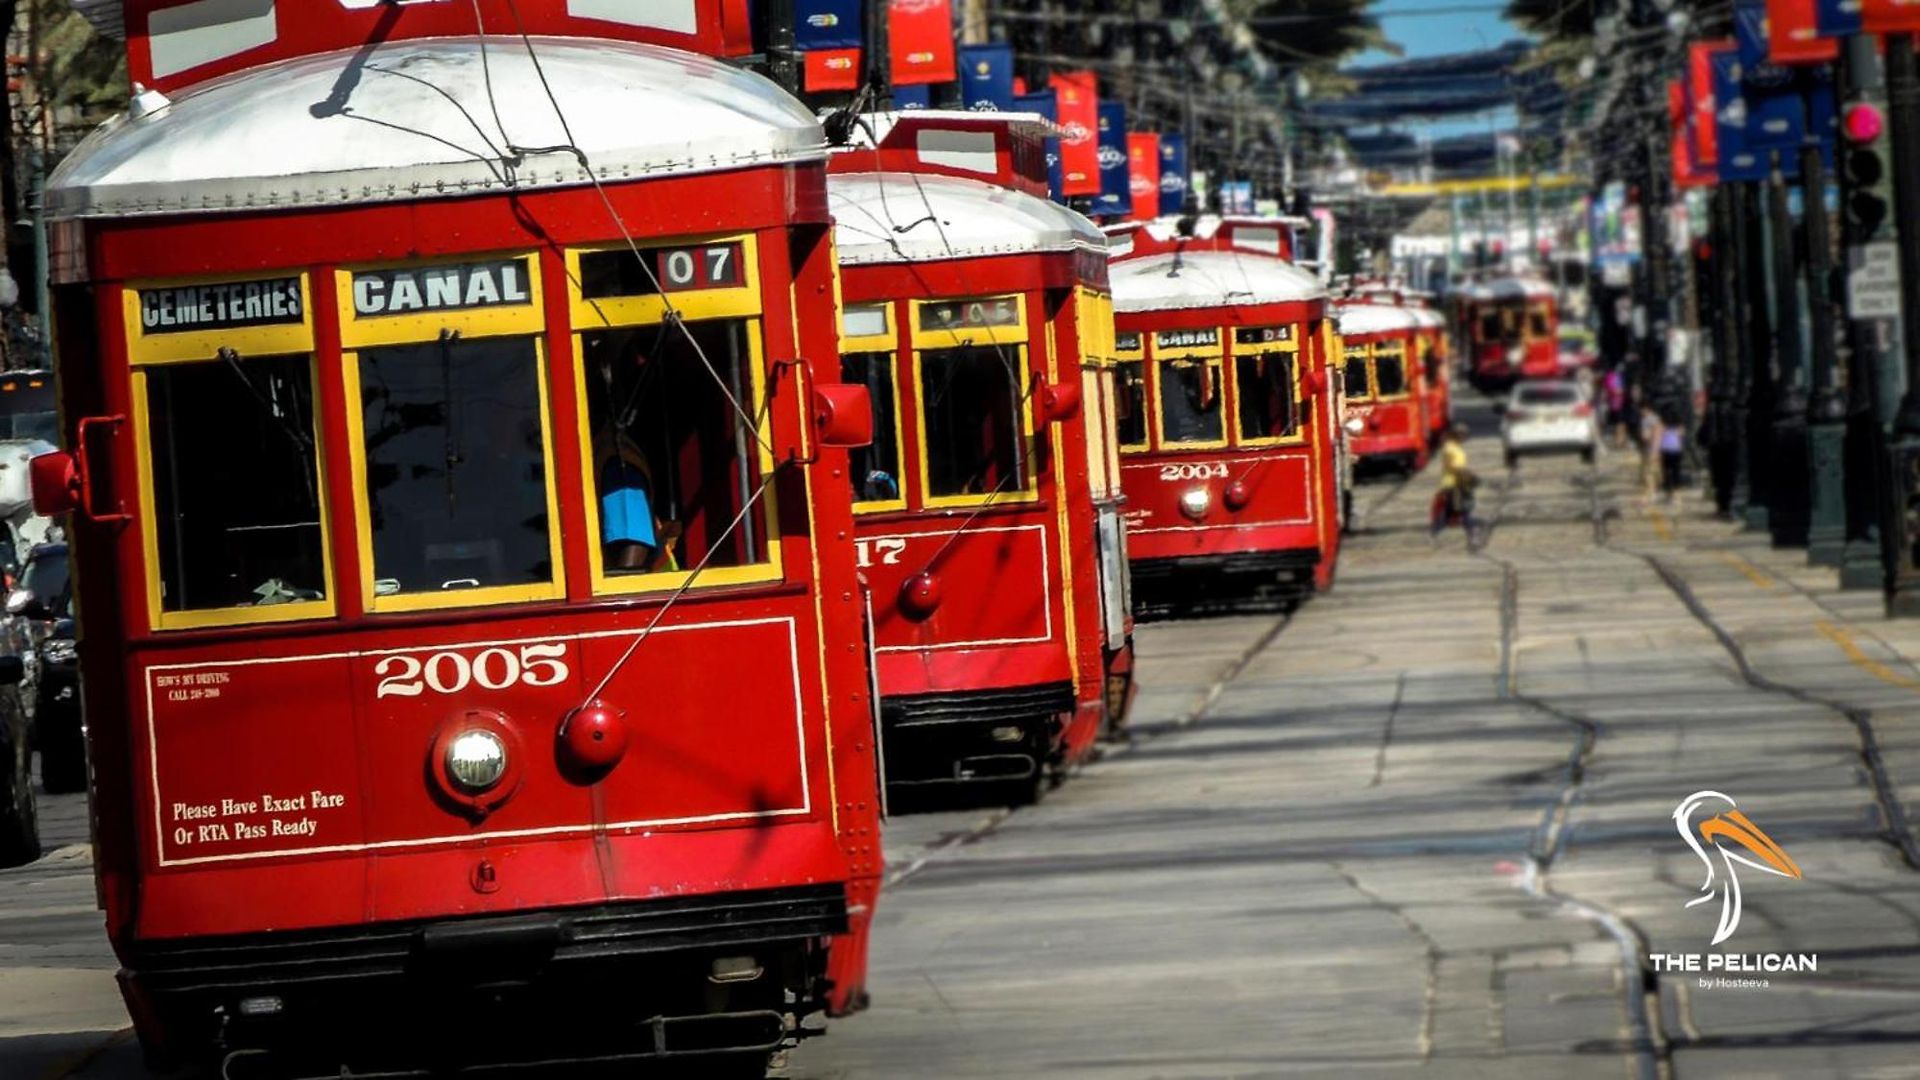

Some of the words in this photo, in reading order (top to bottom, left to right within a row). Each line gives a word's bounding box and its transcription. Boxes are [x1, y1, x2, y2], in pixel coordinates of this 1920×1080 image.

[142, 279, 302, 328] CEMETERIES
[354, 266, 526, 313] CANAL
[1160, 463, 1229, 481] 2004
[375, 643, 569, 699] 2005
[168, 690, 189, 701] CALL
[173, 801, 217, 821] Please
[222, 798, 257, 817] Have
[263, 794, 306, 814] Exact
[311, 790, 345, 809] Fare
[174, 827, 194, 845] Or
[199, 824, 229, 843] RTA
[235, 821, 267, 839] Pass
[272, 817, 317, 837] Ready
